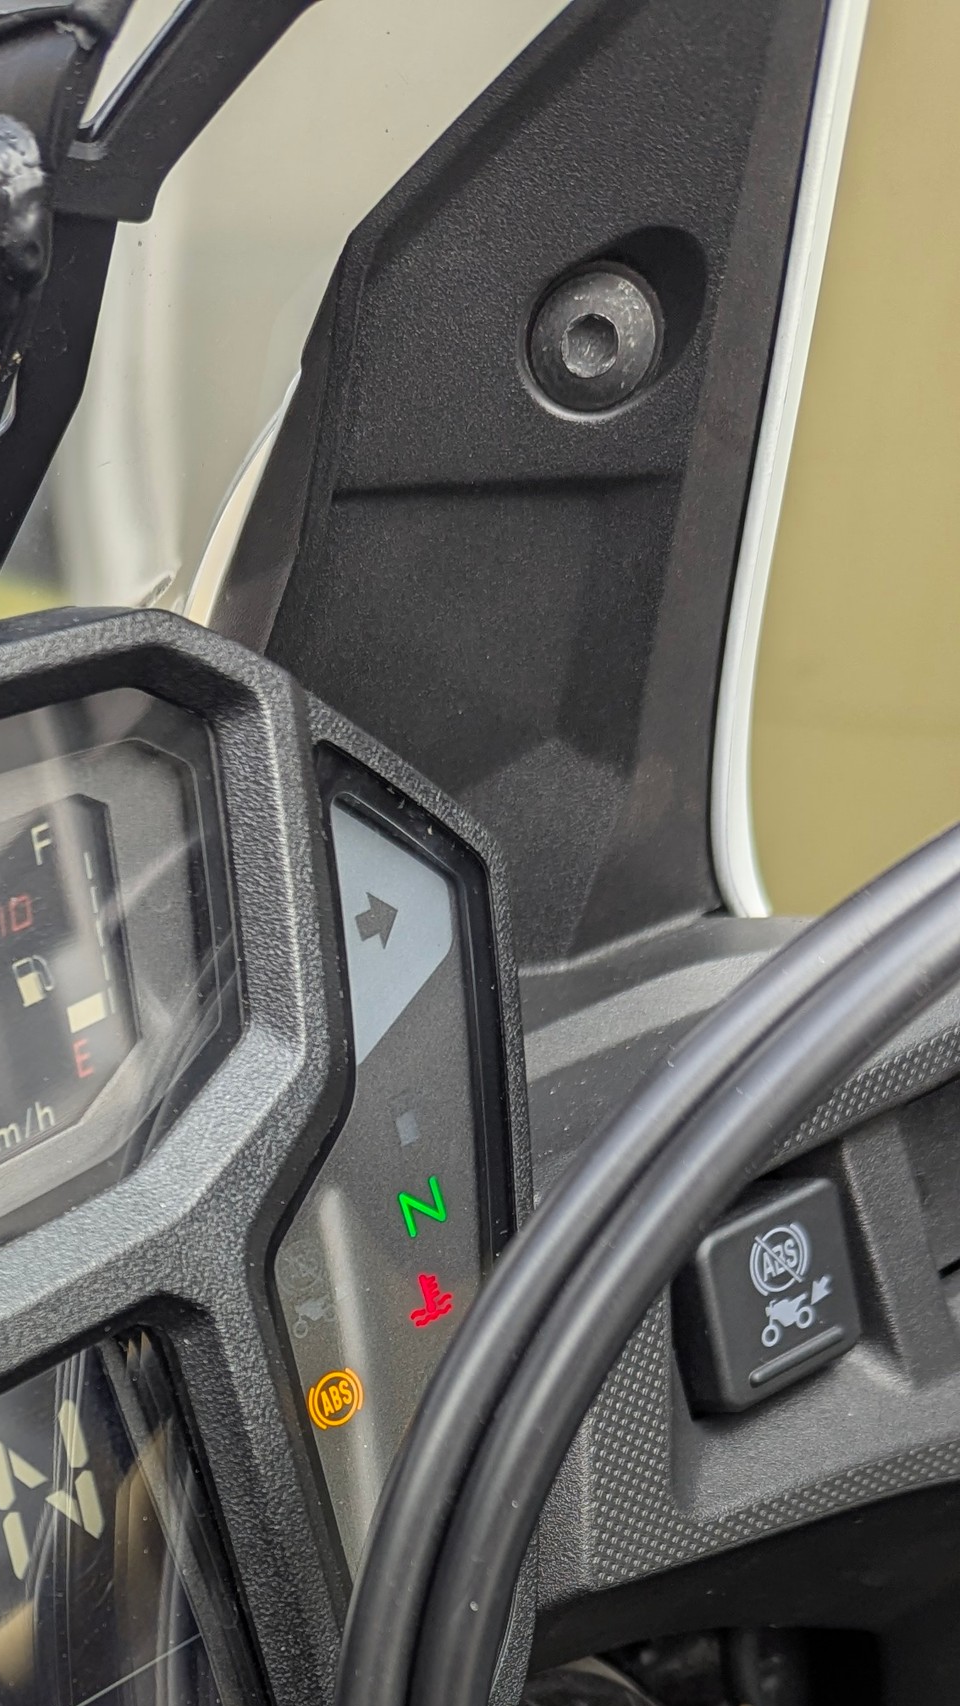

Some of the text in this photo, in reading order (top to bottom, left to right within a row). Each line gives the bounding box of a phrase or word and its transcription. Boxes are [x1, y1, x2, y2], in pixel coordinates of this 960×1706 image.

[31, 822, 53, 866] F
[72, 1038, 94, 1078] E
[397, 1176, 447, 1238] N
[320, 1380, 353, 1417] ABS
